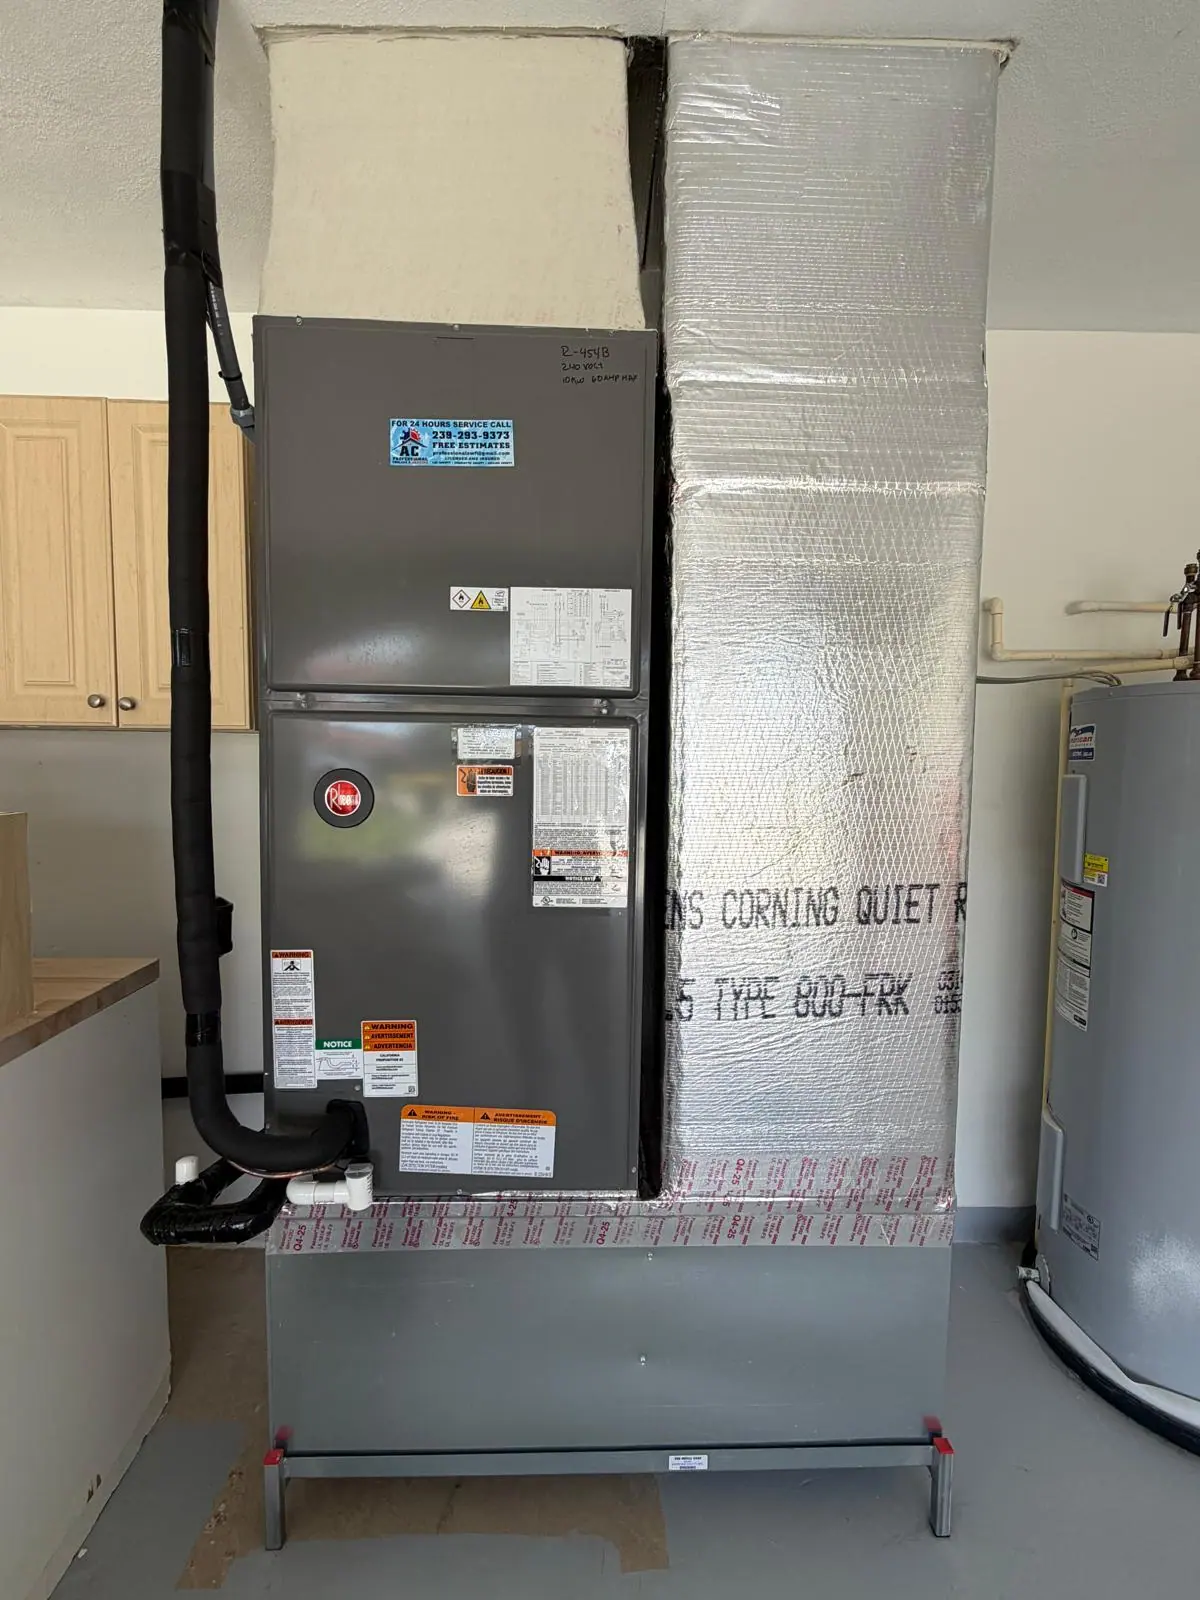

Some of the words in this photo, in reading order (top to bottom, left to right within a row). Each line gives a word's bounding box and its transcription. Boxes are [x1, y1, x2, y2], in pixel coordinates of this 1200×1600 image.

[560, 345, 610, 358] R-454B
[561, 362, 580, 370] 240
[432, 431, 510, 440] 239-293-9373
[400, 446, 419, 456] AC
[722, 886, 840, 930] CORNING
[856, 884, 940, 925] QUIET
[954, 882, 968, 923] R
[714, 976, 780, 1021] TYPE
[794, 972, 914, 1018] 800-FRK
[731, 1158, 746, 1186] Q4-25
[293, 1224, 307, 1251] Q4-25
[596, 1221, 610, 1245] Q4-25
[727, 1214, 742, 1240] Q4-25
